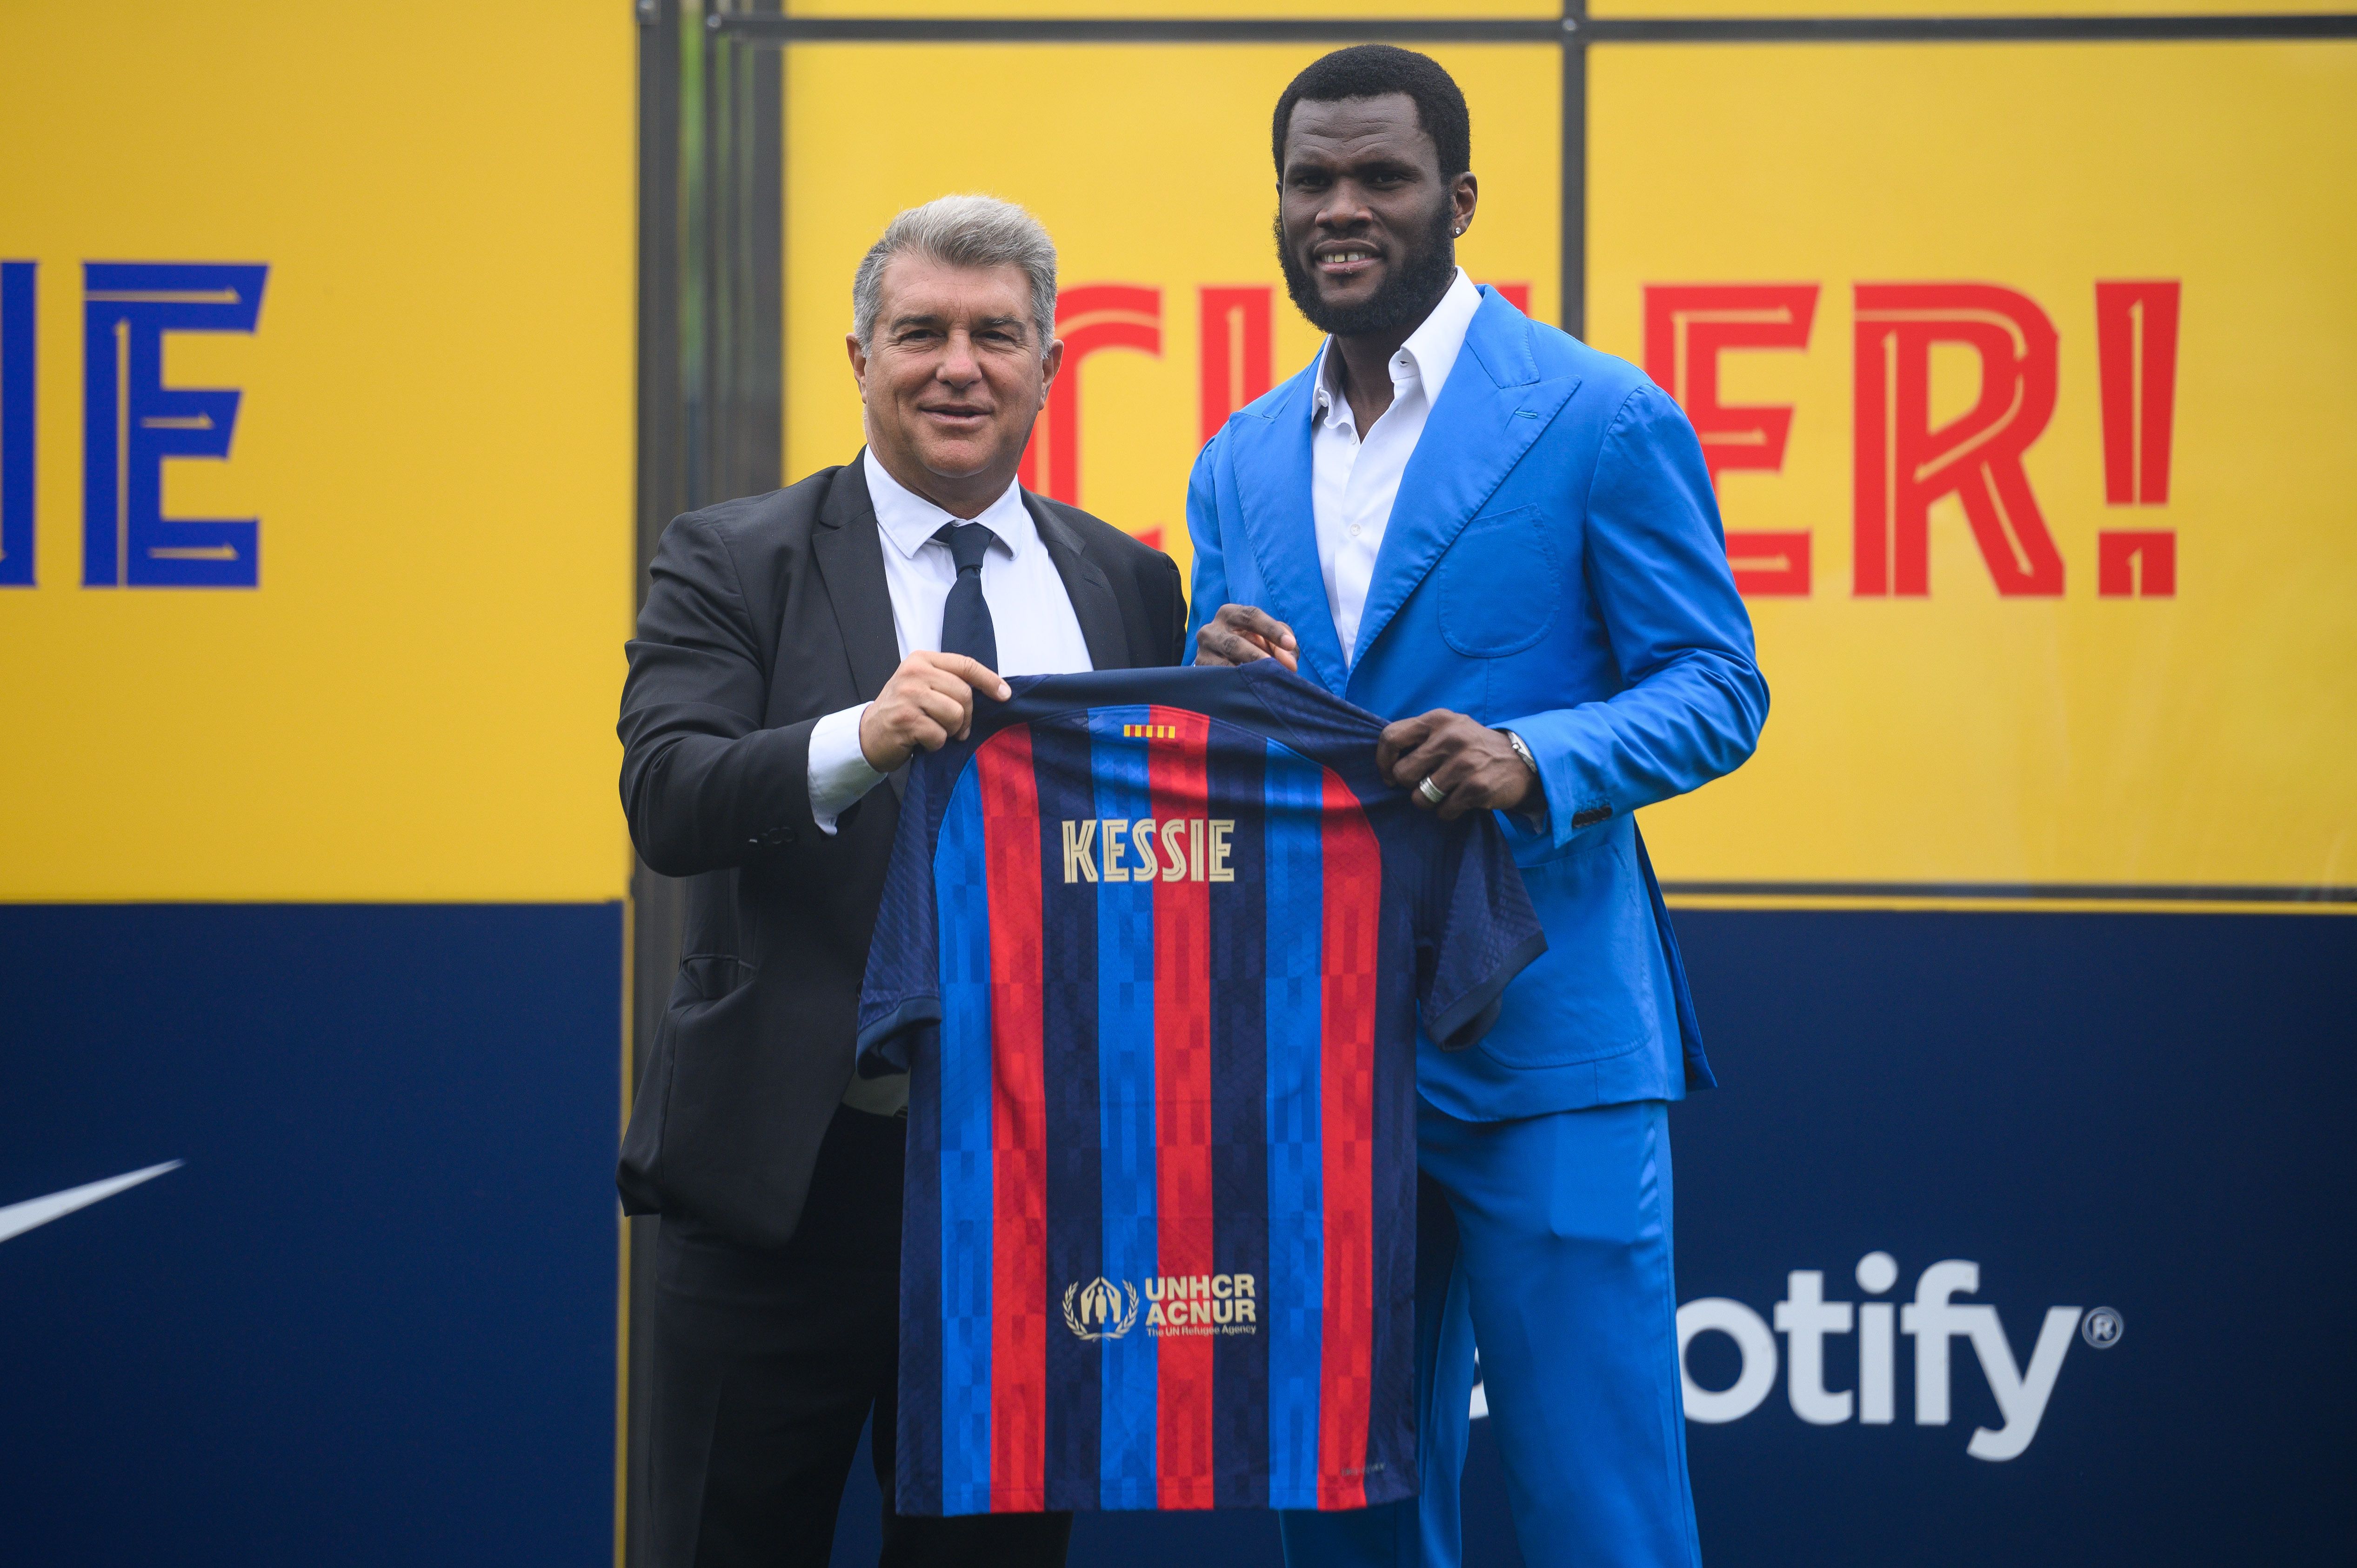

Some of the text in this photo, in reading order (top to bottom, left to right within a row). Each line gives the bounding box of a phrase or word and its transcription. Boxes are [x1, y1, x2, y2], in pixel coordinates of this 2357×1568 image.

[1018, 280, 2182, 599] CER!
[1062, 819, 1235, 883] KESSIE
[1145, 1274, 1255, 1301] UNHCR
[1145, 1298, 1256, 1326] ACNUR
[1147, 1324, 1256, 1337] The UN Refugee Agency
